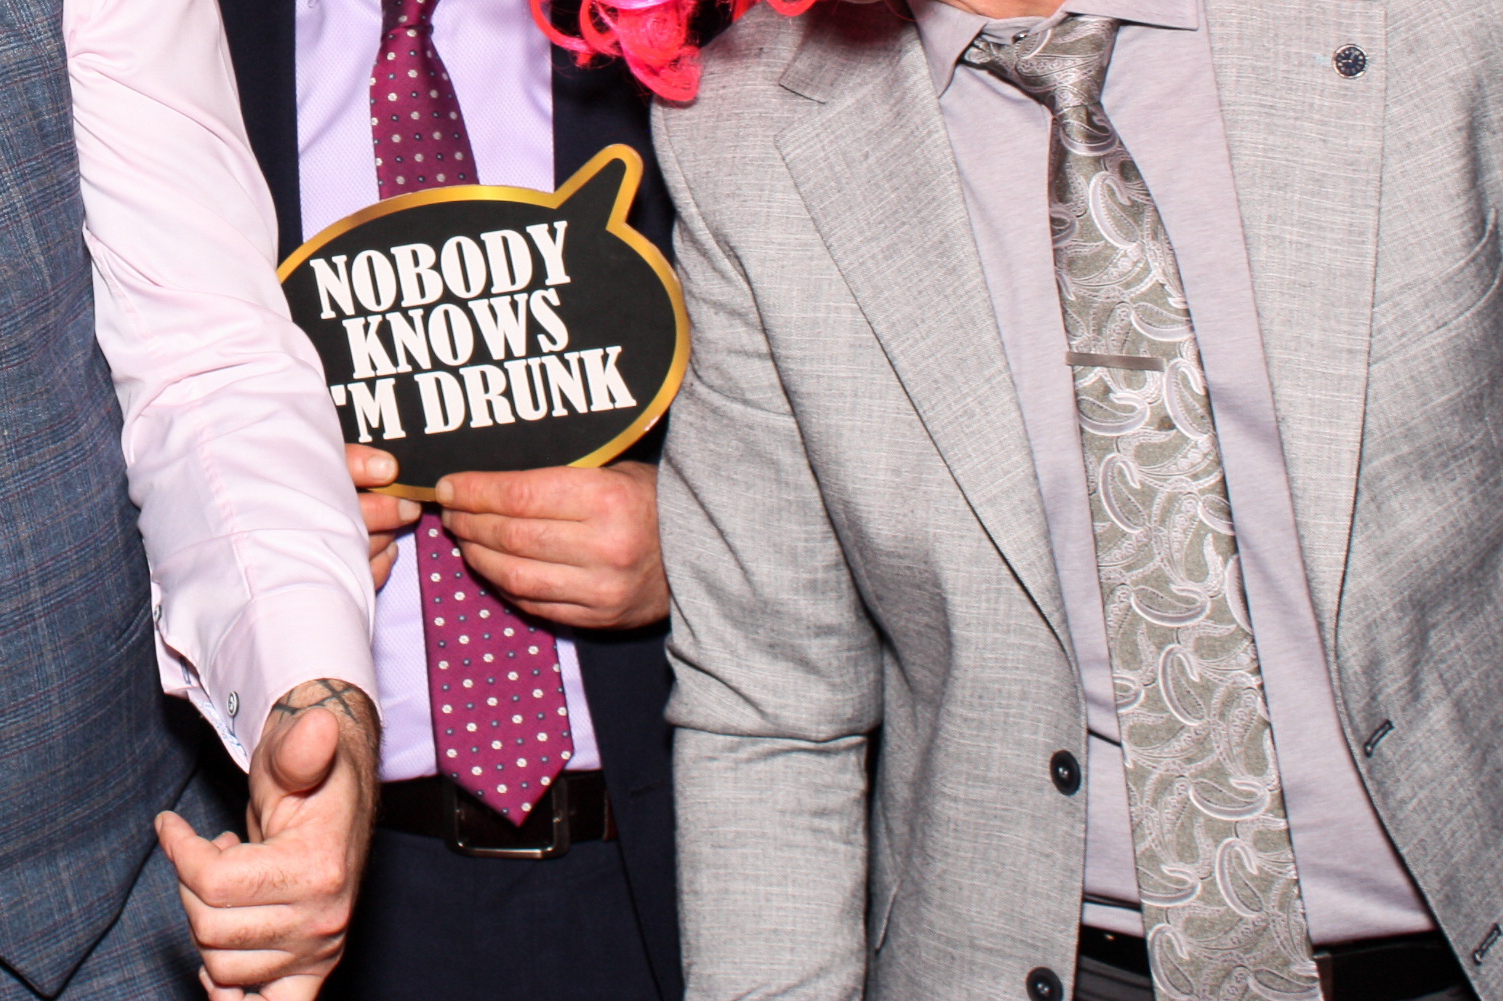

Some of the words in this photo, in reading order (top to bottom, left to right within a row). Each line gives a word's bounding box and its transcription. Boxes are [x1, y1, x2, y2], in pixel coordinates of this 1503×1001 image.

[309, 220, 571, 319] NOBODY
[341, 288, 569, 380] KNOWS
[329, 377, 406, 443] 'M
[413, 345, 637, 435] DRUNK
